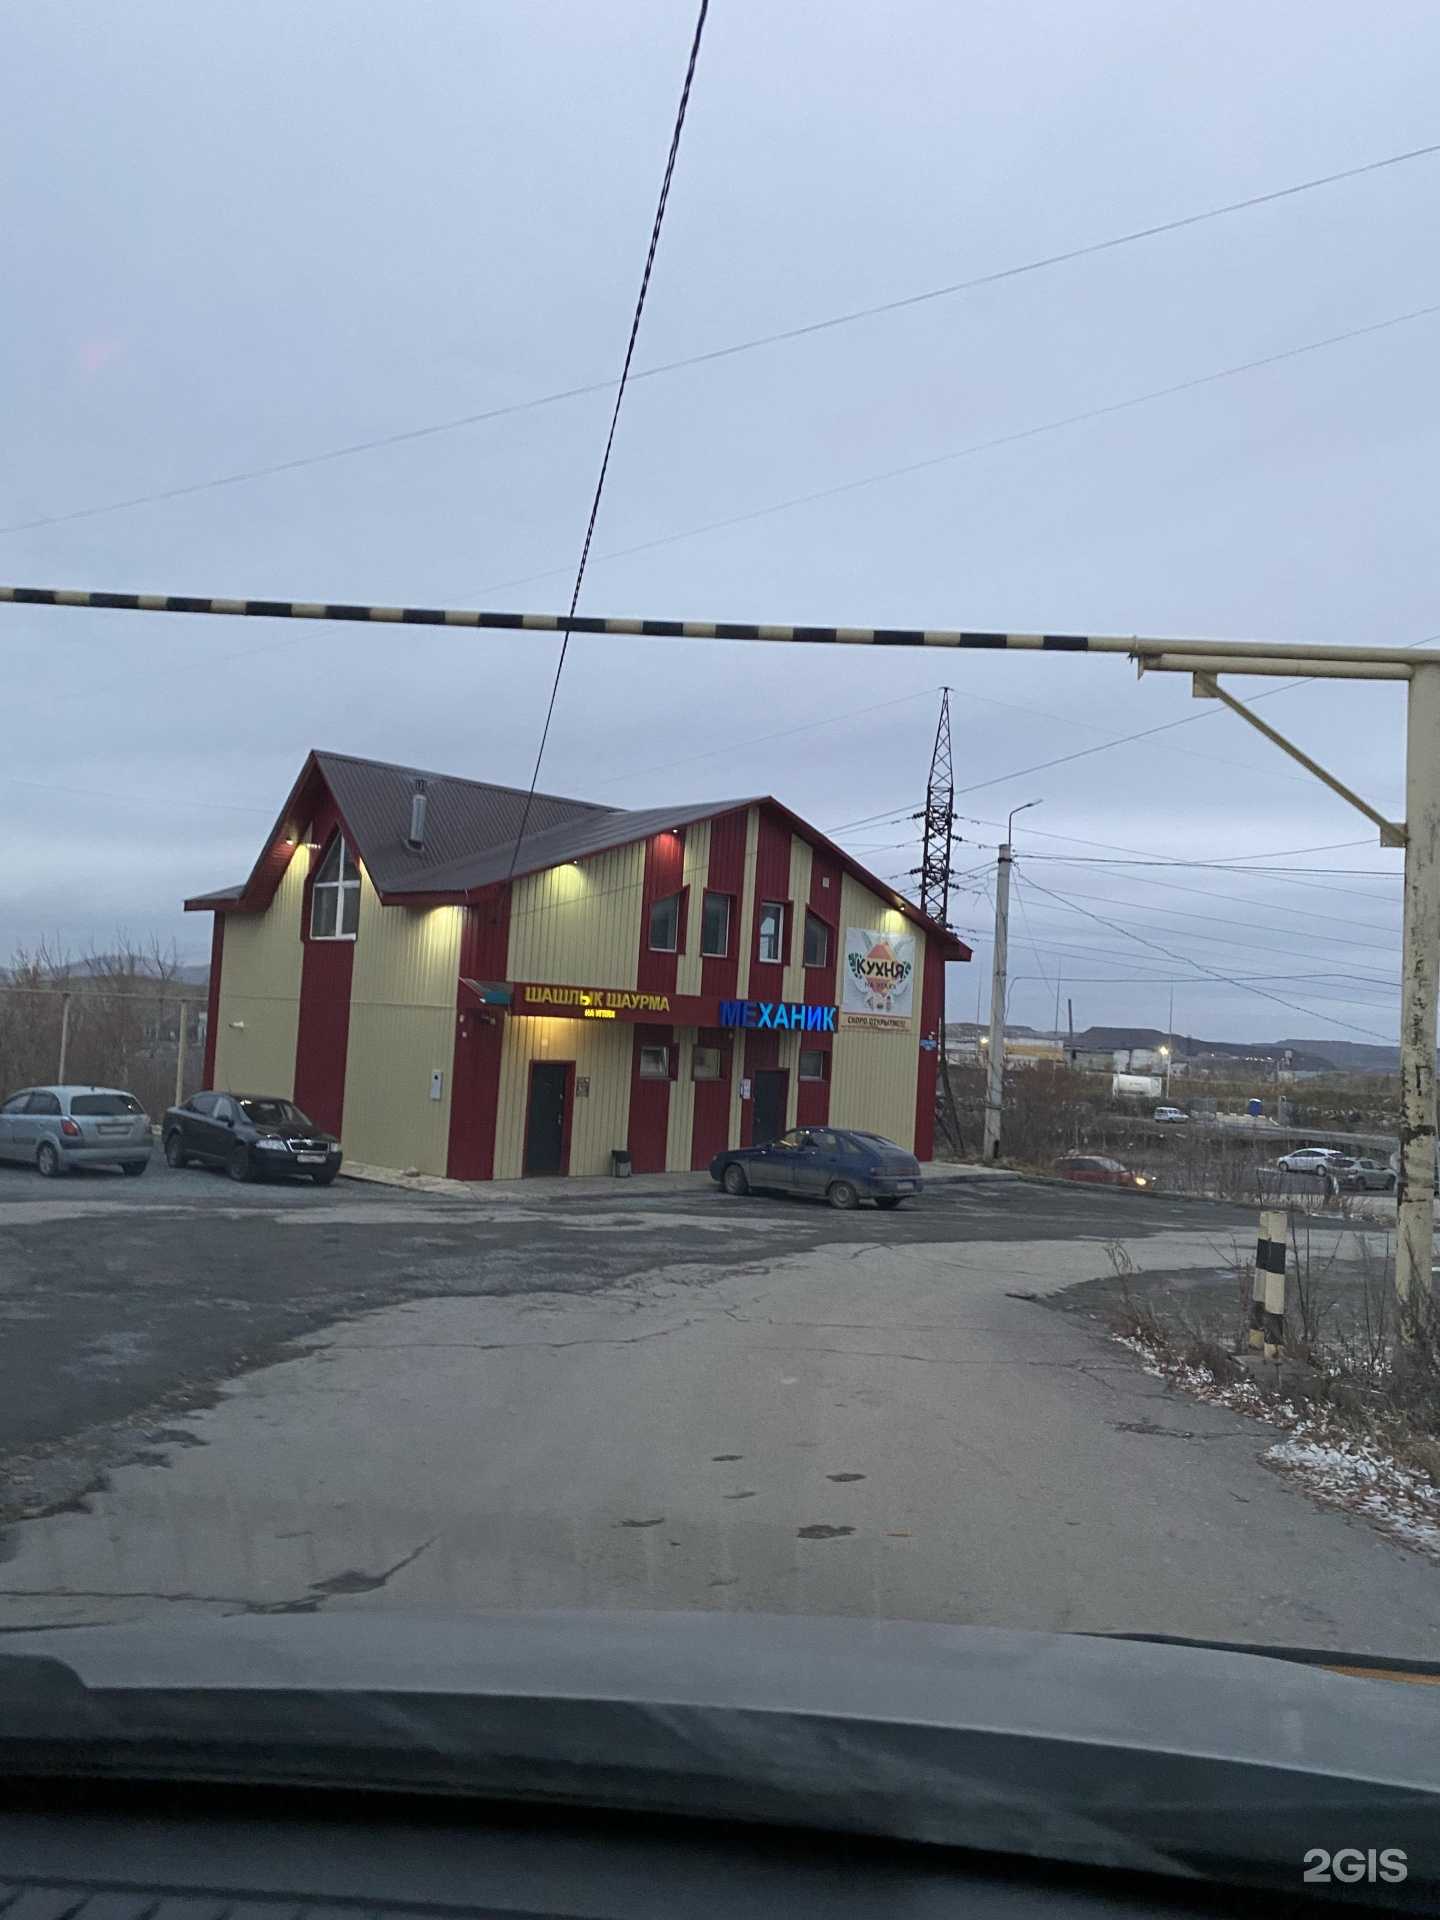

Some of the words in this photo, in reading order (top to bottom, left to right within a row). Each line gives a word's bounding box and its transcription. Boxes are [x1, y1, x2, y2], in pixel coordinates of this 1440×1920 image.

[857, 959, 904, 978] КУХНЯ
[525, 986, 603, 1007] ШАШЛЫК
[606, 991, 670, 1012] ШАУРМА
[720, 1001, 837, 1032] МЕХАНИК
